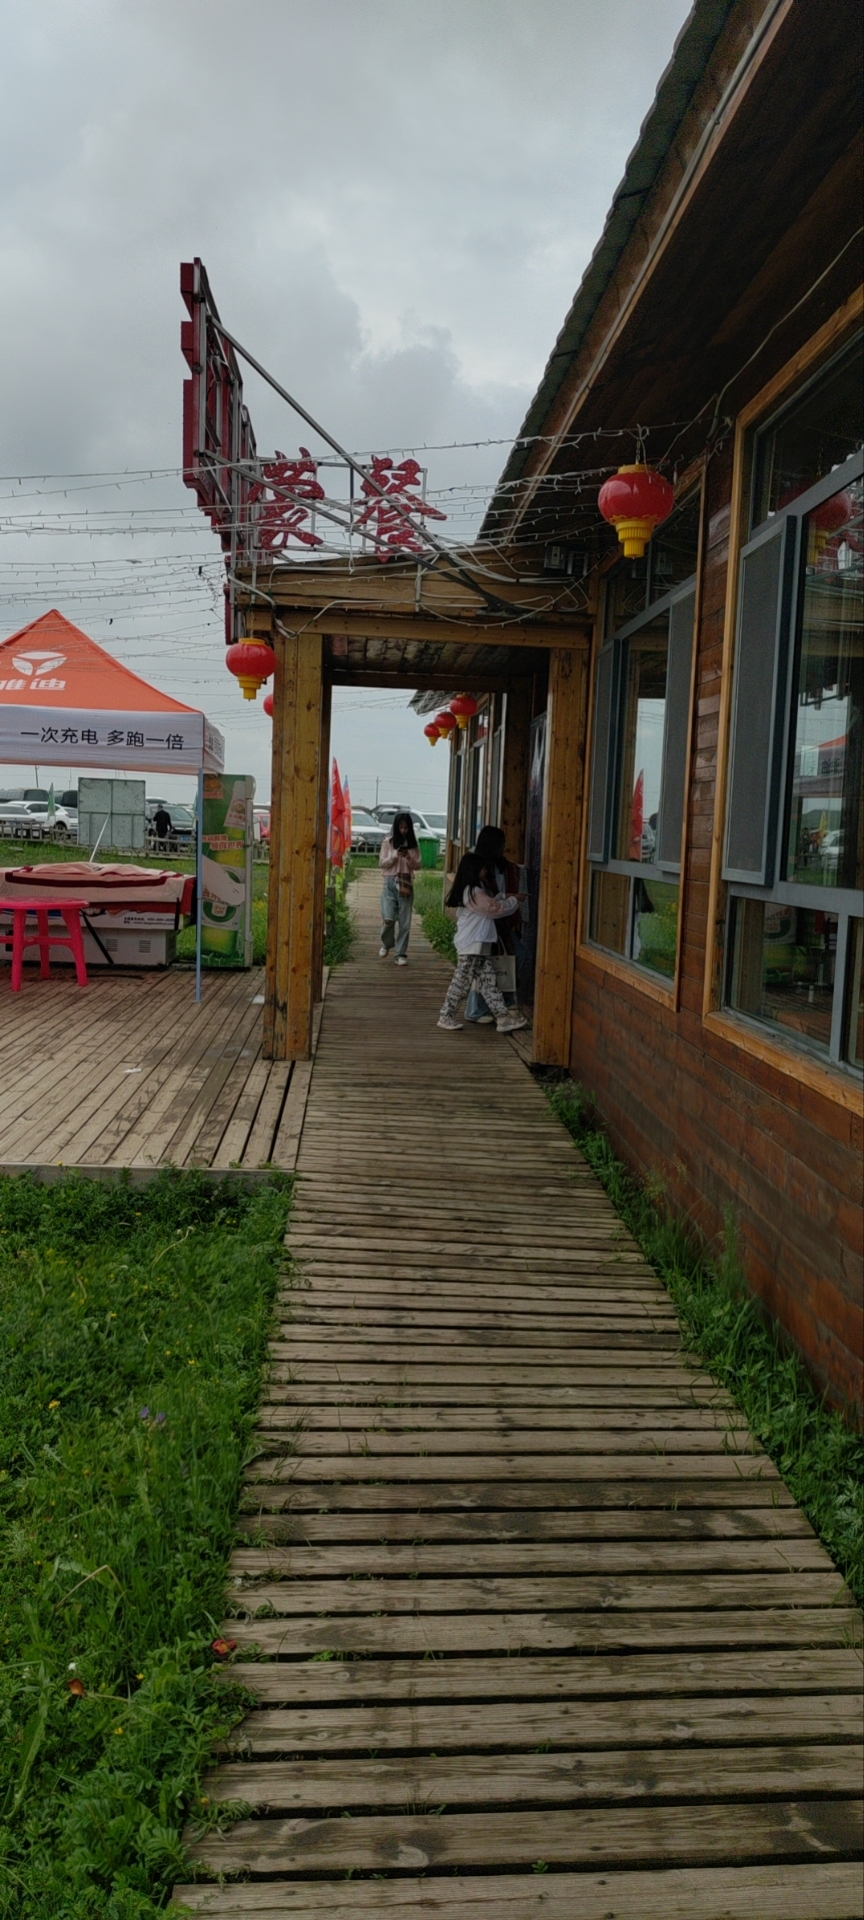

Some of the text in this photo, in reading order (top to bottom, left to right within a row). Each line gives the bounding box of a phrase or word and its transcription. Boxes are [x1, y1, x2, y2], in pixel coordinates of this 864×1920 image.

[247, 446, 448, 564] 蒙餐
[20, 726, 184, 750] 一次充电 多跑一倍
